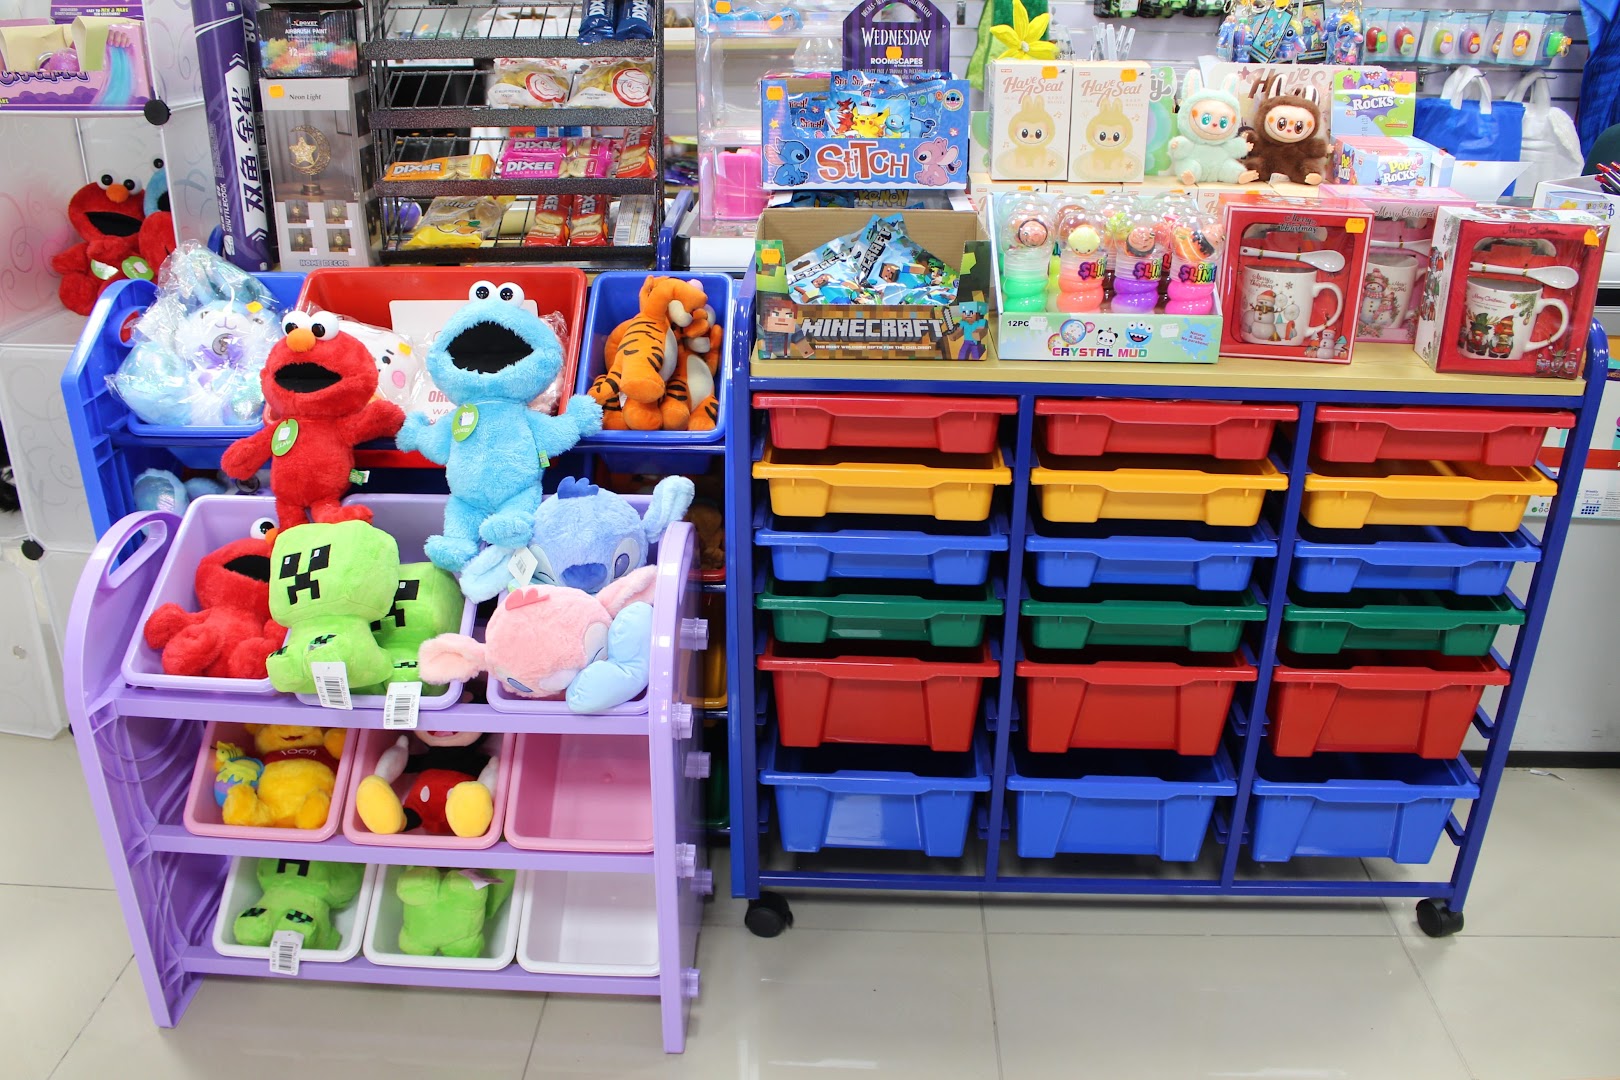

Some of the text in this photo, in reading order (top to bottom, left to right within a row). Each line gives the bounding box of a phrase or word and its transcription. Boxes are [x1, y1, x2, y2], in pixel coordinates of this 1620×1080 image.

[1003, 76, 1036, 93] Have
[1034, 77, 1064, 94] Seat
[1081, 79, 1115, 96] Have
[1112, 80, 1142, 97] Seat
[307, 94, 321, 102] Light
[506, 161, 554, 172] DIXEE
[1375, 206, 1400, 221] Merry
[1502, 226, 1528, 236] Merry
[802, 318, 943, 341] MINECRAFT
[1052, 347, 1147, 358] CRYSTAL MUD
